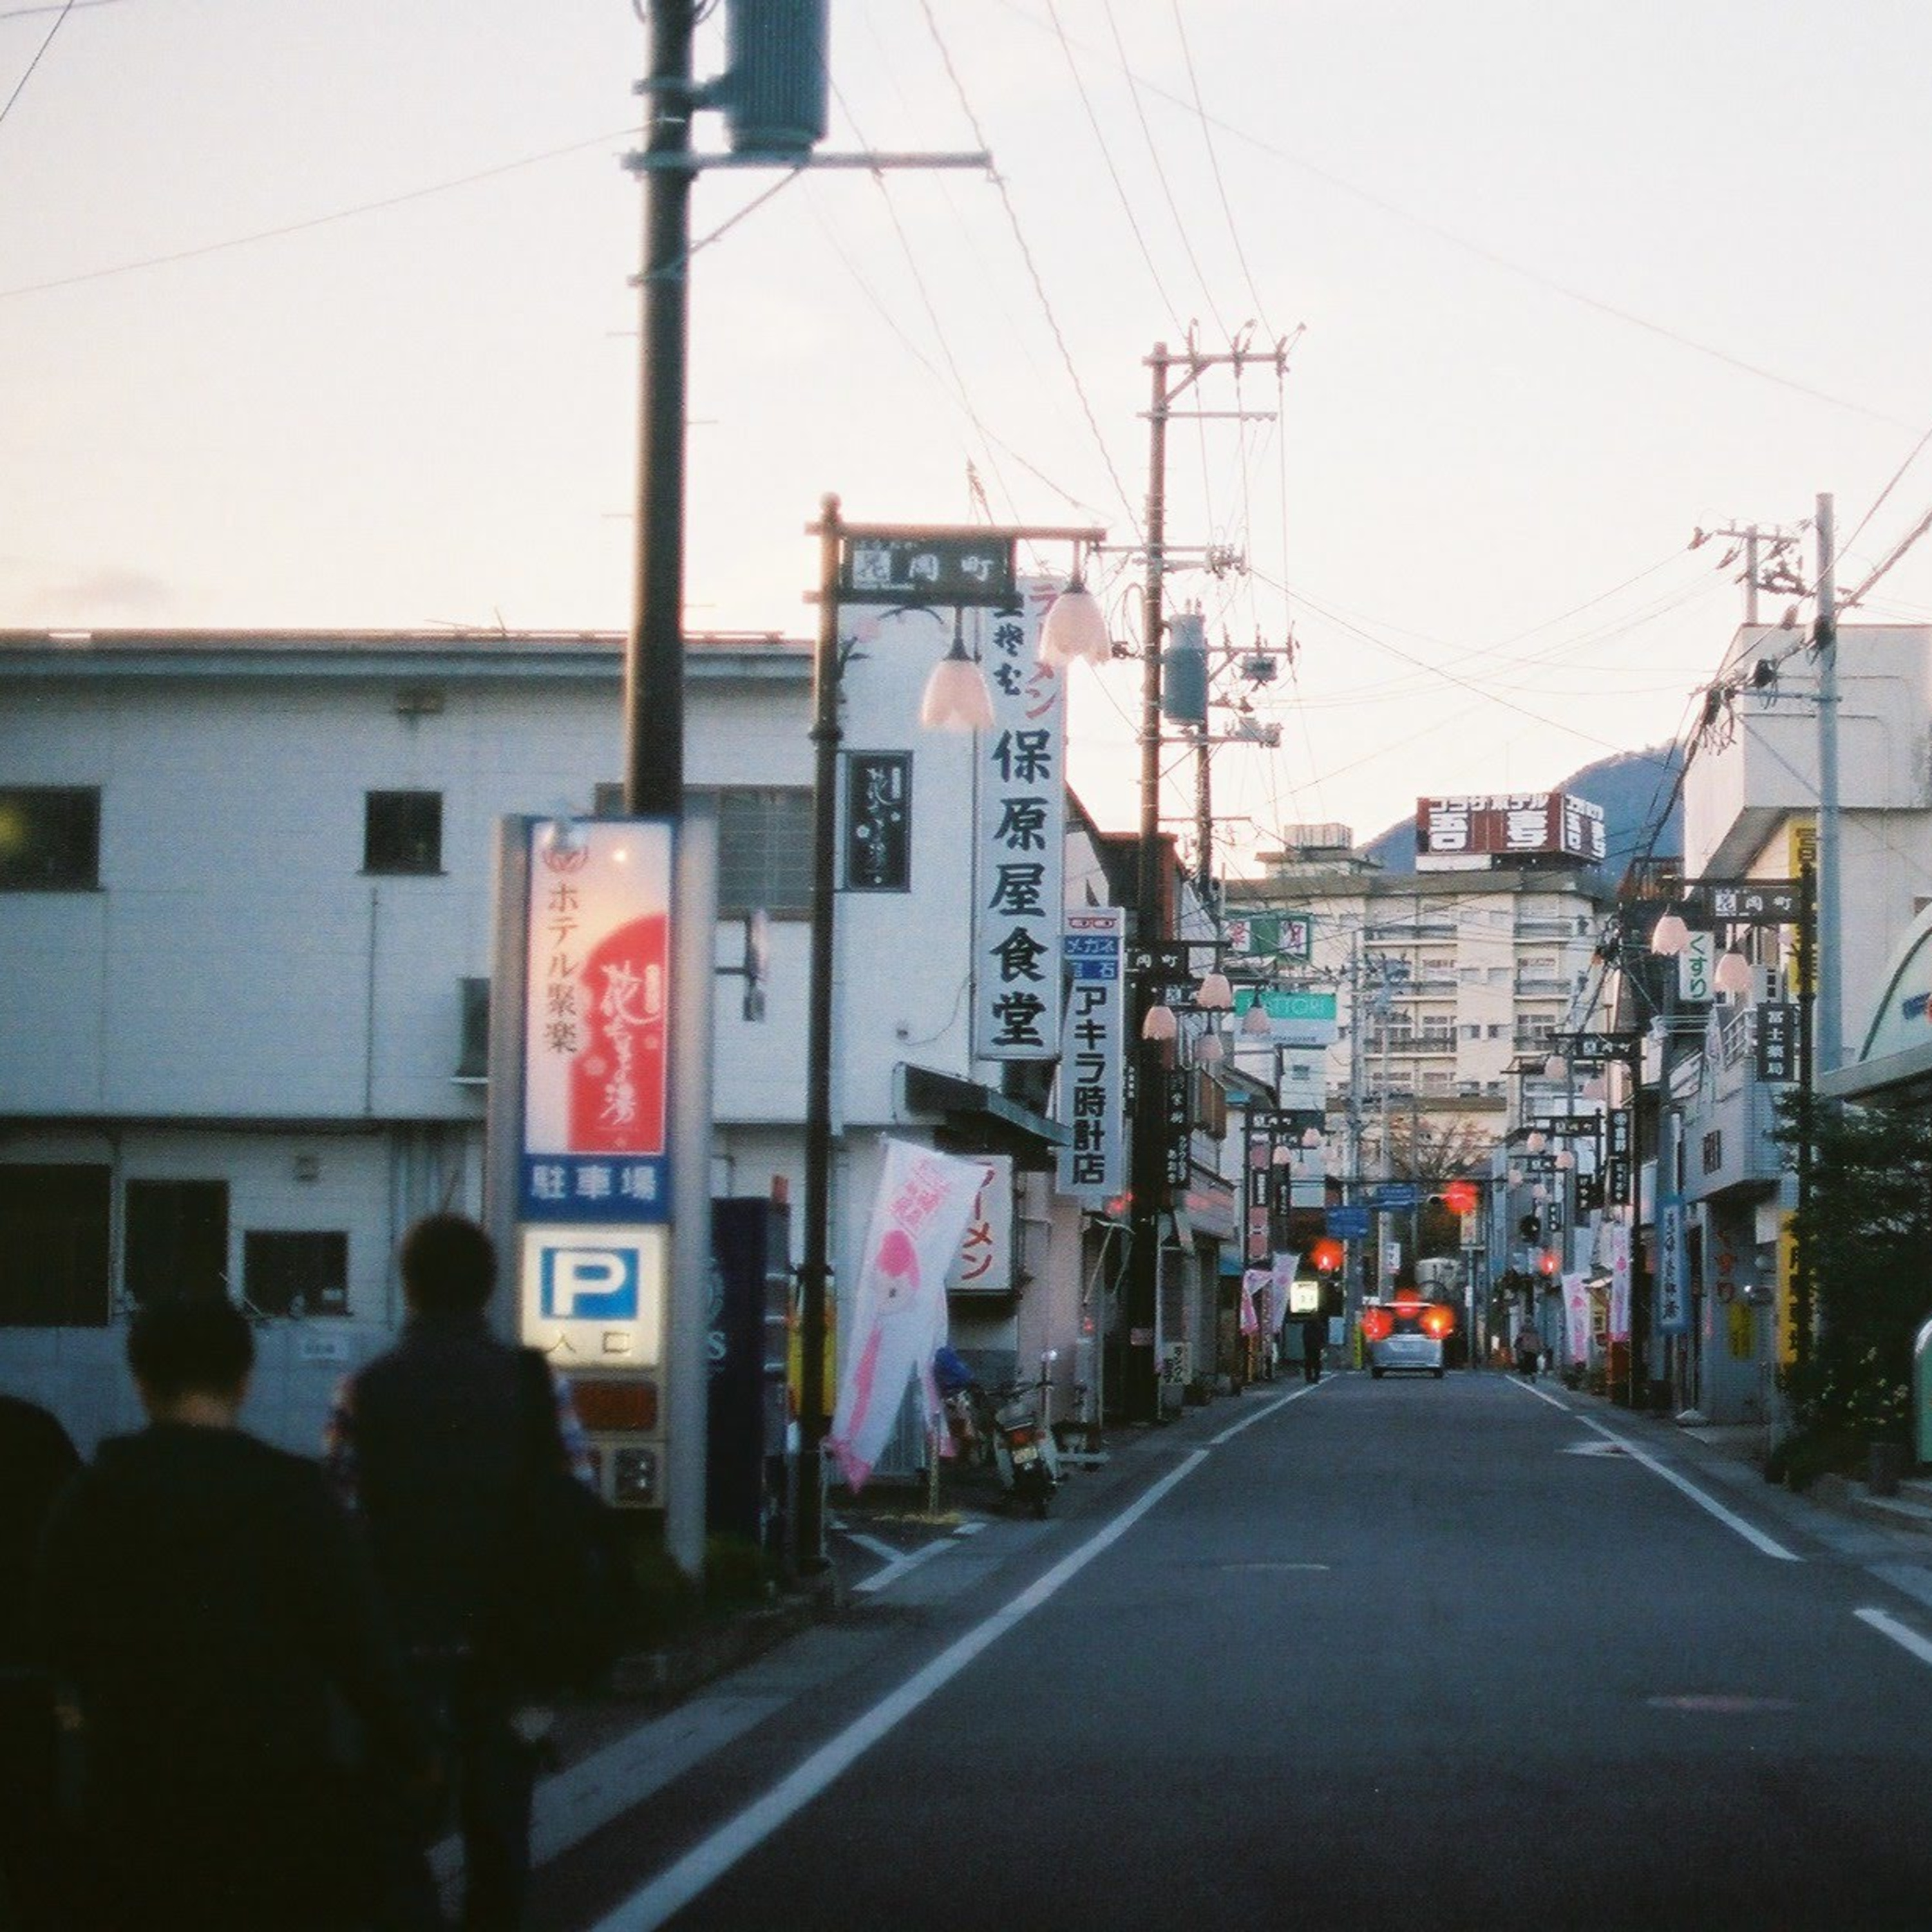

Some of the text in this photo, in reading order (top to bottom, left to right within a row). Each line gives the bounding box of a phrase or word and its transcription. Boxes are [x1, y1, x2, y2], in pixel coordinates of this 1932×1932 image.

[988, 728, 1052, 1048] 保原屋食堂
[544, 882, 578, 1055] ホテル聚楽
[1066, 938, 1115, 953] メガネ
[1689, 934, 1707, 999] くすり
[1072, 986, 1107, 1184] アキラ時計店
[531, 1164, 657, 1200] 駐車場
[552, 1251, 626, 1315] P
[544, 1331, 634, 1354] 入口
